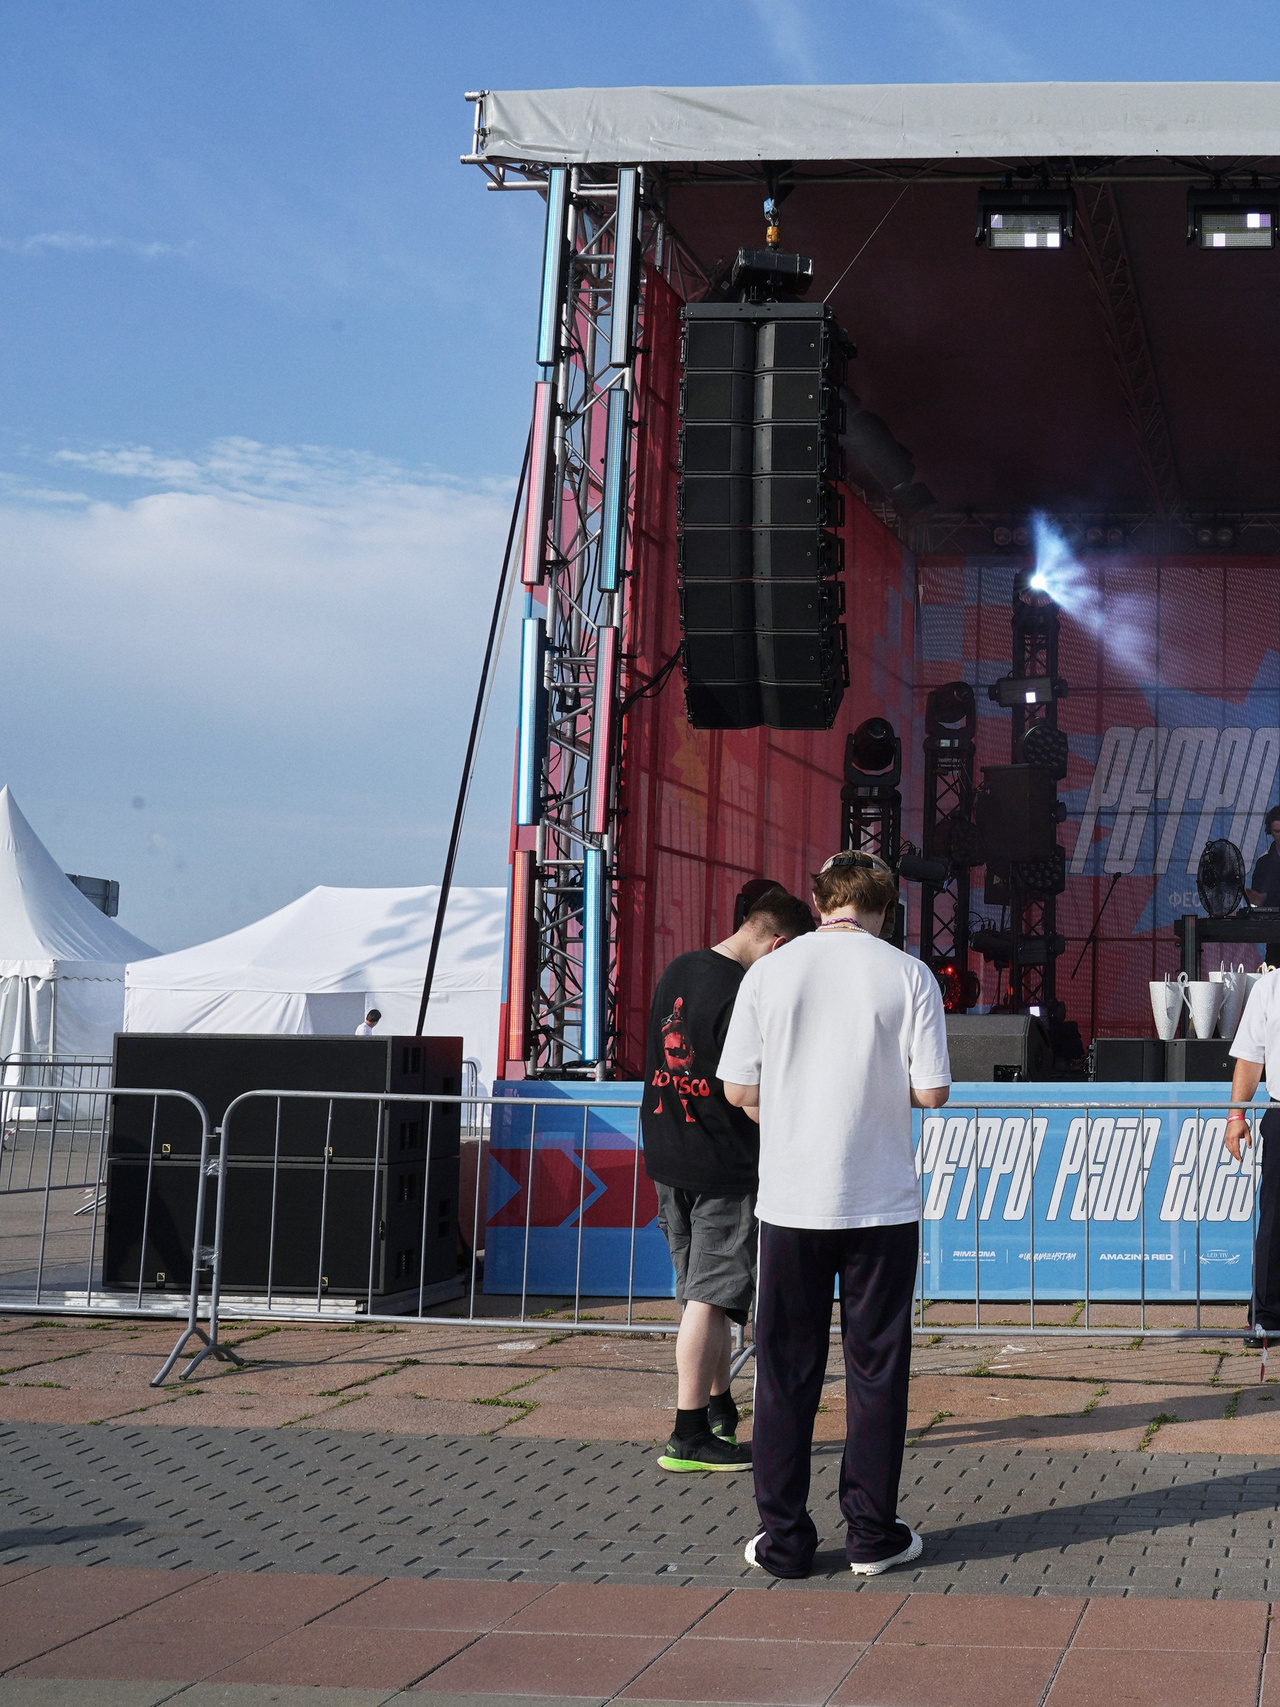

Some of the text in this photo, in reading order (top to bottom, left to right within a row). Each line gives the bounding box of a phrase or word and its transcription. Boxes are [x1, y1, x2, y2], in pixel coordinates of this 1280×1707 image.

[1045, 1116, 1163, 1221] РЕЙС
[1159, 1117, 1264, 1222] 2025
[1099, 1253, 1174, 1261] AMAZING RED
